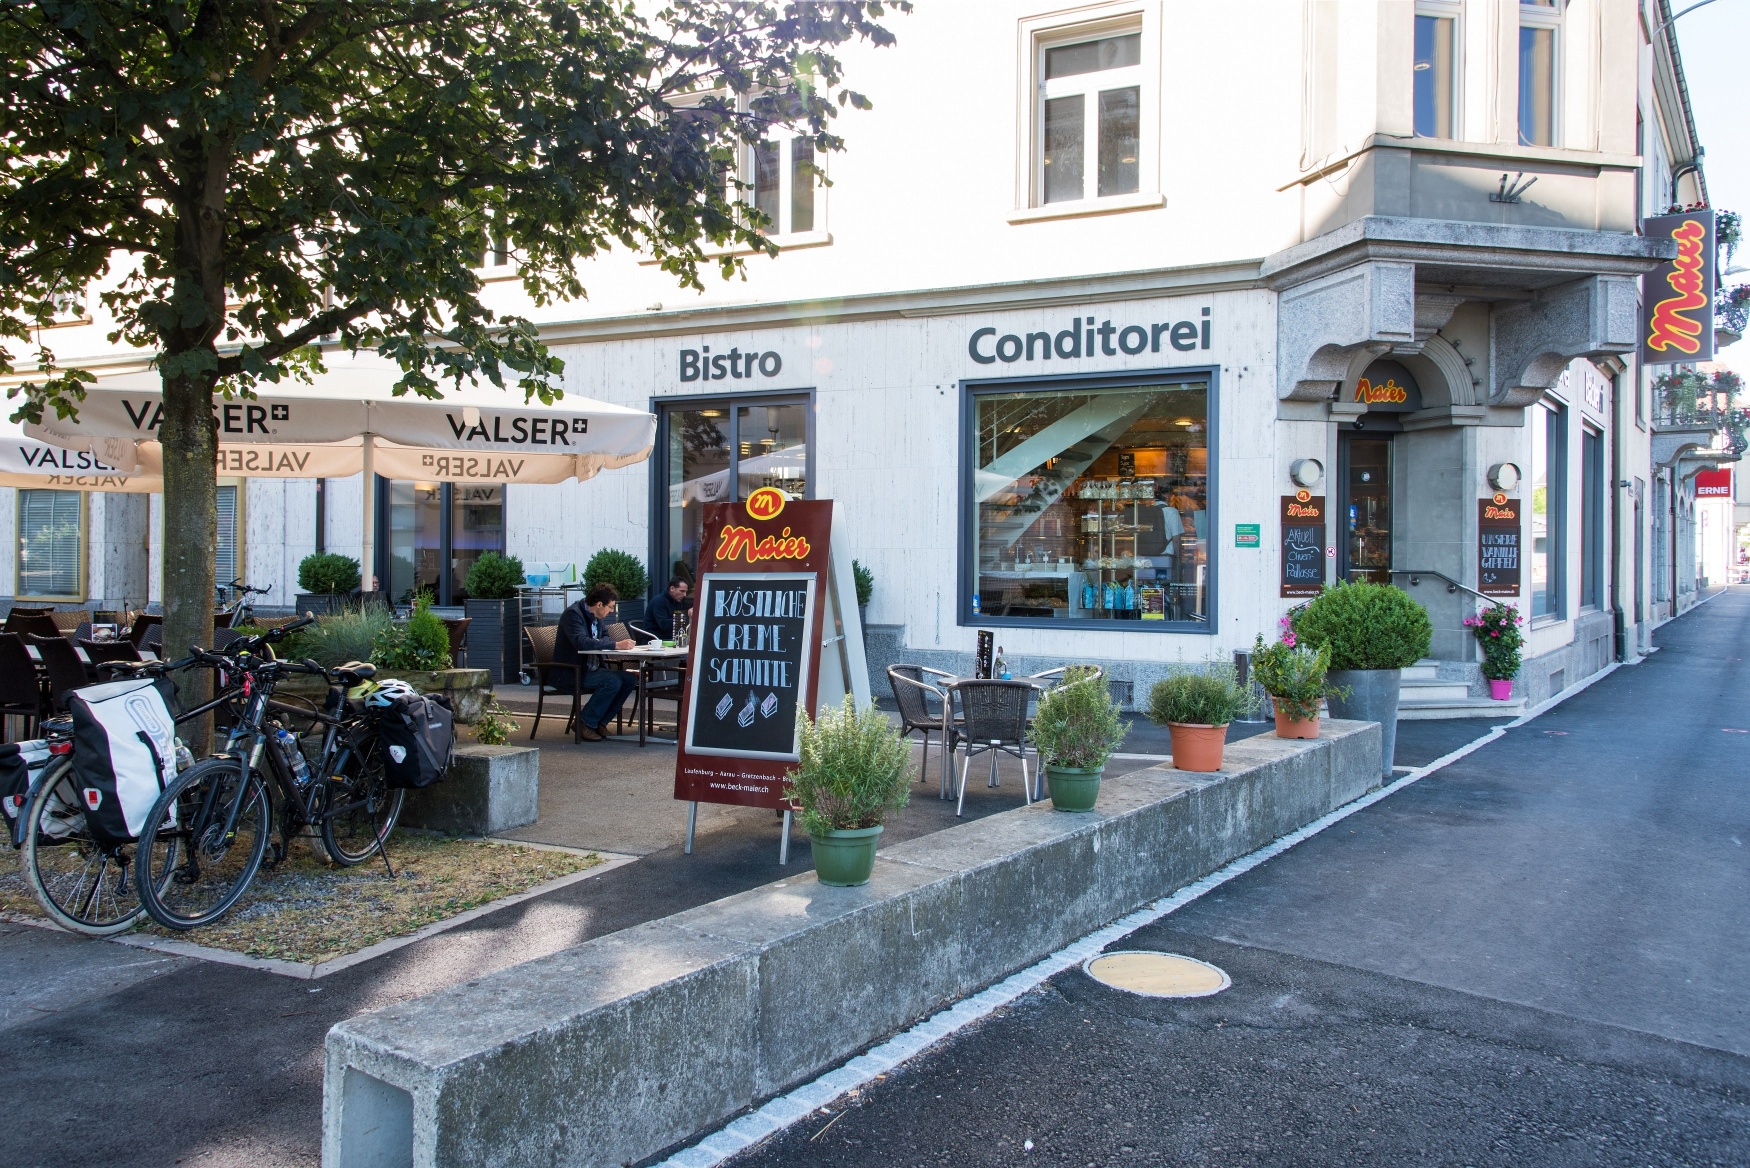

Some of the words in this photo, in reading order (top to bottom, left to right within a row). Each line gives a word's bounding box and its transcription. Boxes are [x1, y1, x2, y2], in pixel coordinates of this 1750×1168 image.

[968, 306, 1211, 364] Conditorei
[679, 345, 782, 382] Bistro
[446, 413, 571, 446] VALSER
[1697, 486, 1728, 495] ERNE
[1287, 503, 1319, 517] Maier
[1484, 506, 1515, 519] Maier
[716, 524, 810, 563] Maier
[713, 586, 807, 618] KÖSTLICHE
[708, 657, 793, 688] SCHNITTE
[684, 767, 714, 777] Laufenburg
[719, 770, 736, 778] Aarau
[709, 782, 769, 794] www.beck-maier.ch
